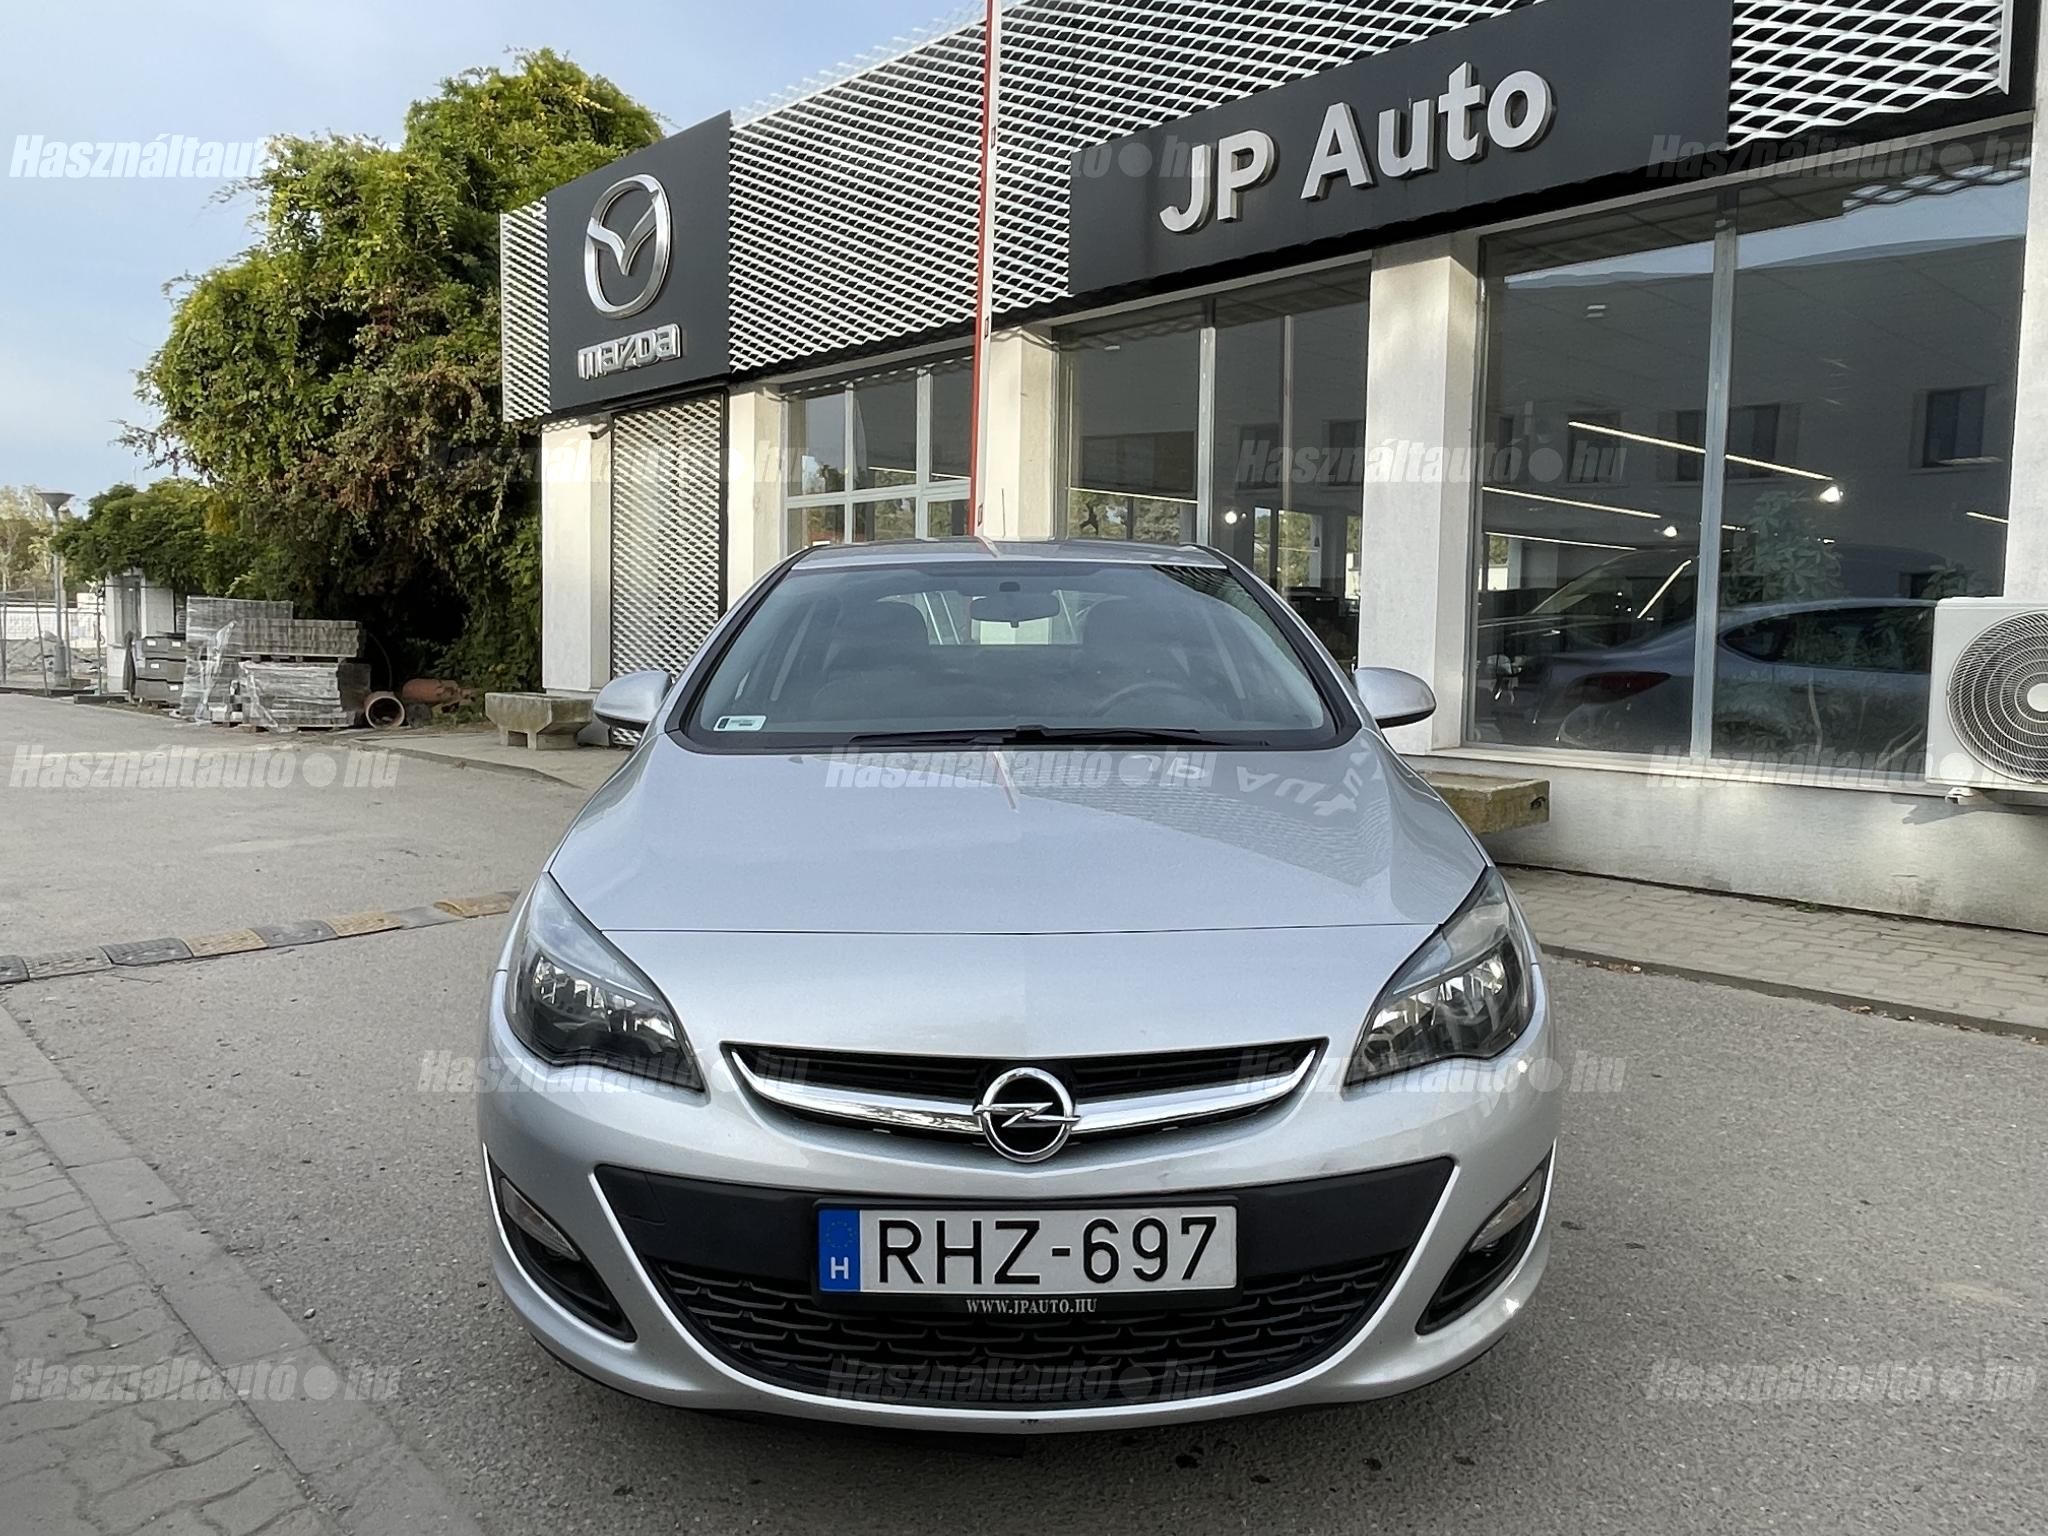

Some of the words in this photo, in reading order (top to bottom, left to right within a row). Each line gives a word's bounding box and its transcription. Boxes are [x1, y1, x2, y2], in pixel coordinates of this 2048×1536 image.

[1159, 129, 1278, 233] JP
[1300, 61, 1556, 200] Auto
[829, 1256, 850, 1280] H
[878, 1217, 1218, 1285] RHZ-697
[966, 1298, 1098, 1315] WWW.JPAUTO.HU
